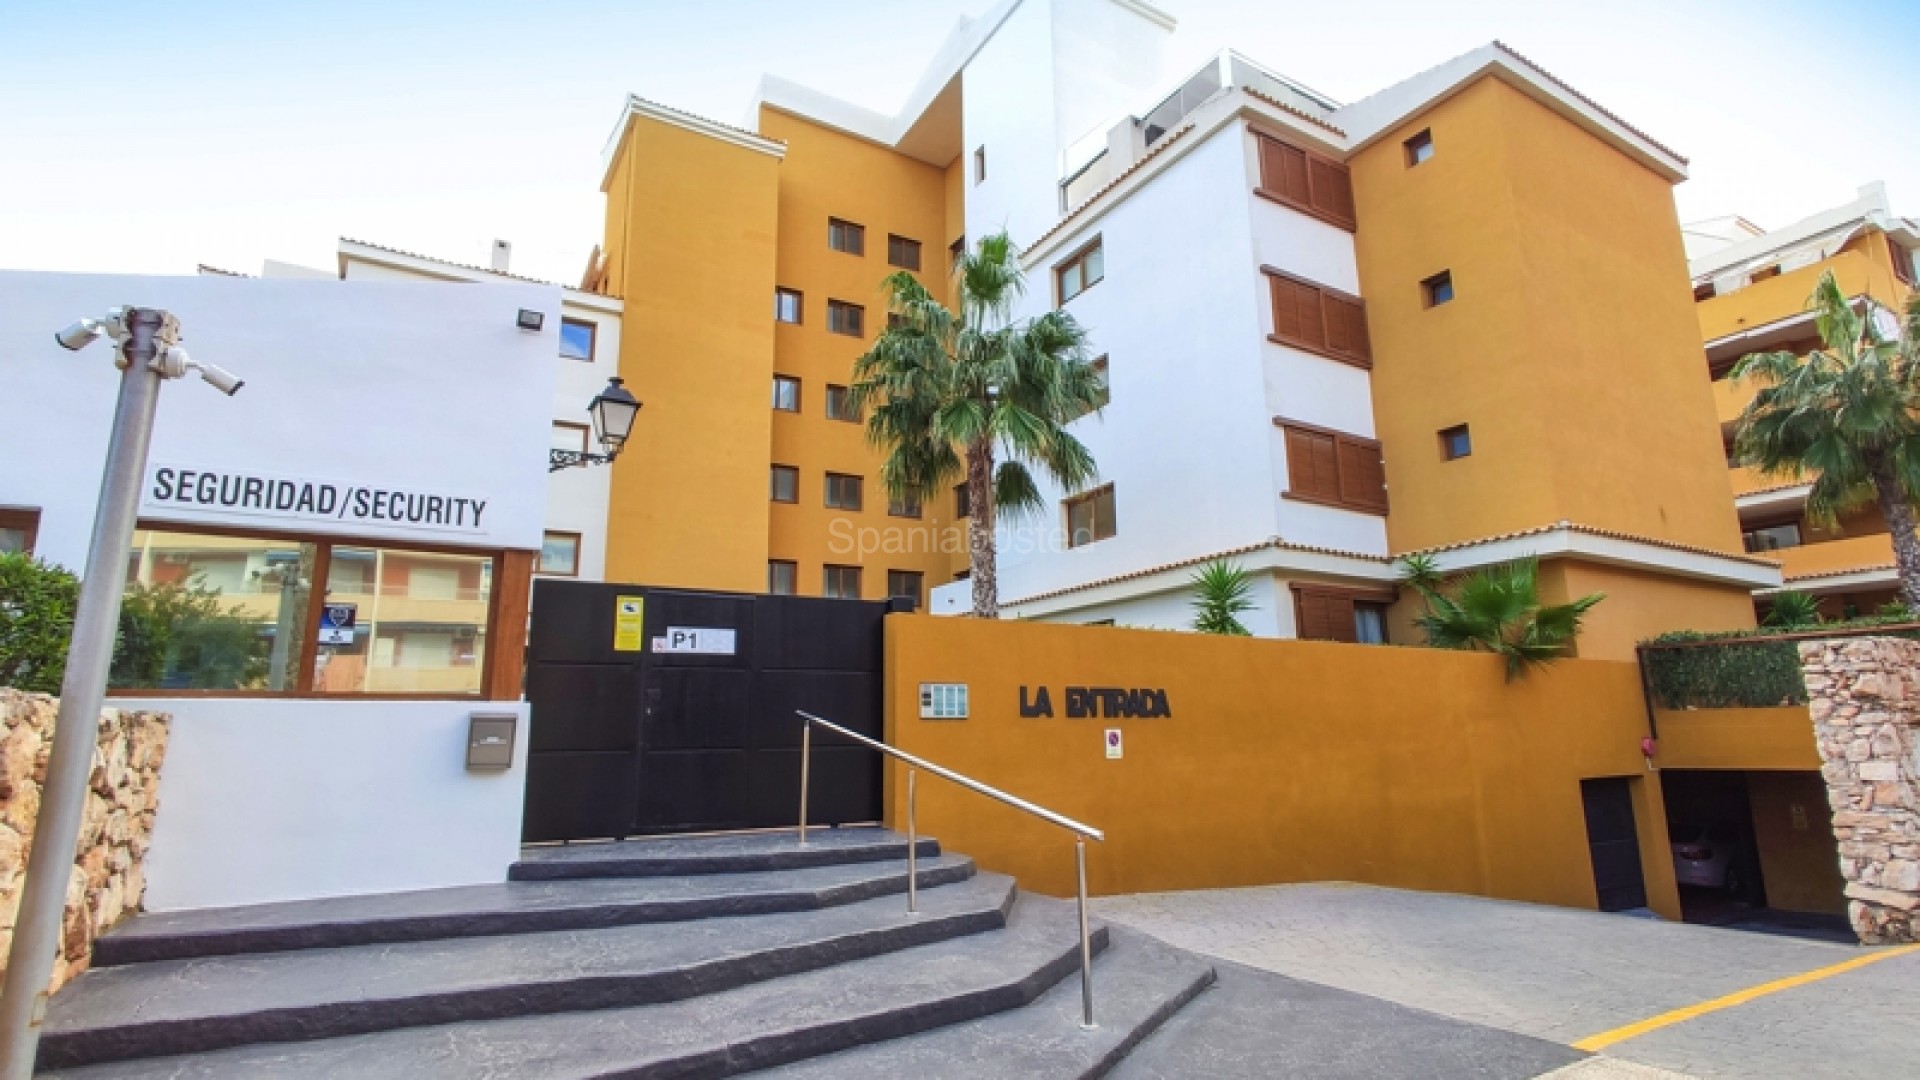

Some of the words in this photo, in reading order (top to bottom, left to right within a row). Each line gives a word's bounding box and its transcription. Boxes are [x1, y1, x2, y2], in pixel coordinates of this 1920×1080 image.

[153, 467, 486, 528] SEGURIDAD/SECURITY
[671, 630, 697, 649] P1
[1019, 685, 1054, 718] LA
[1065, 686, 1172, 718] ENTRADA
